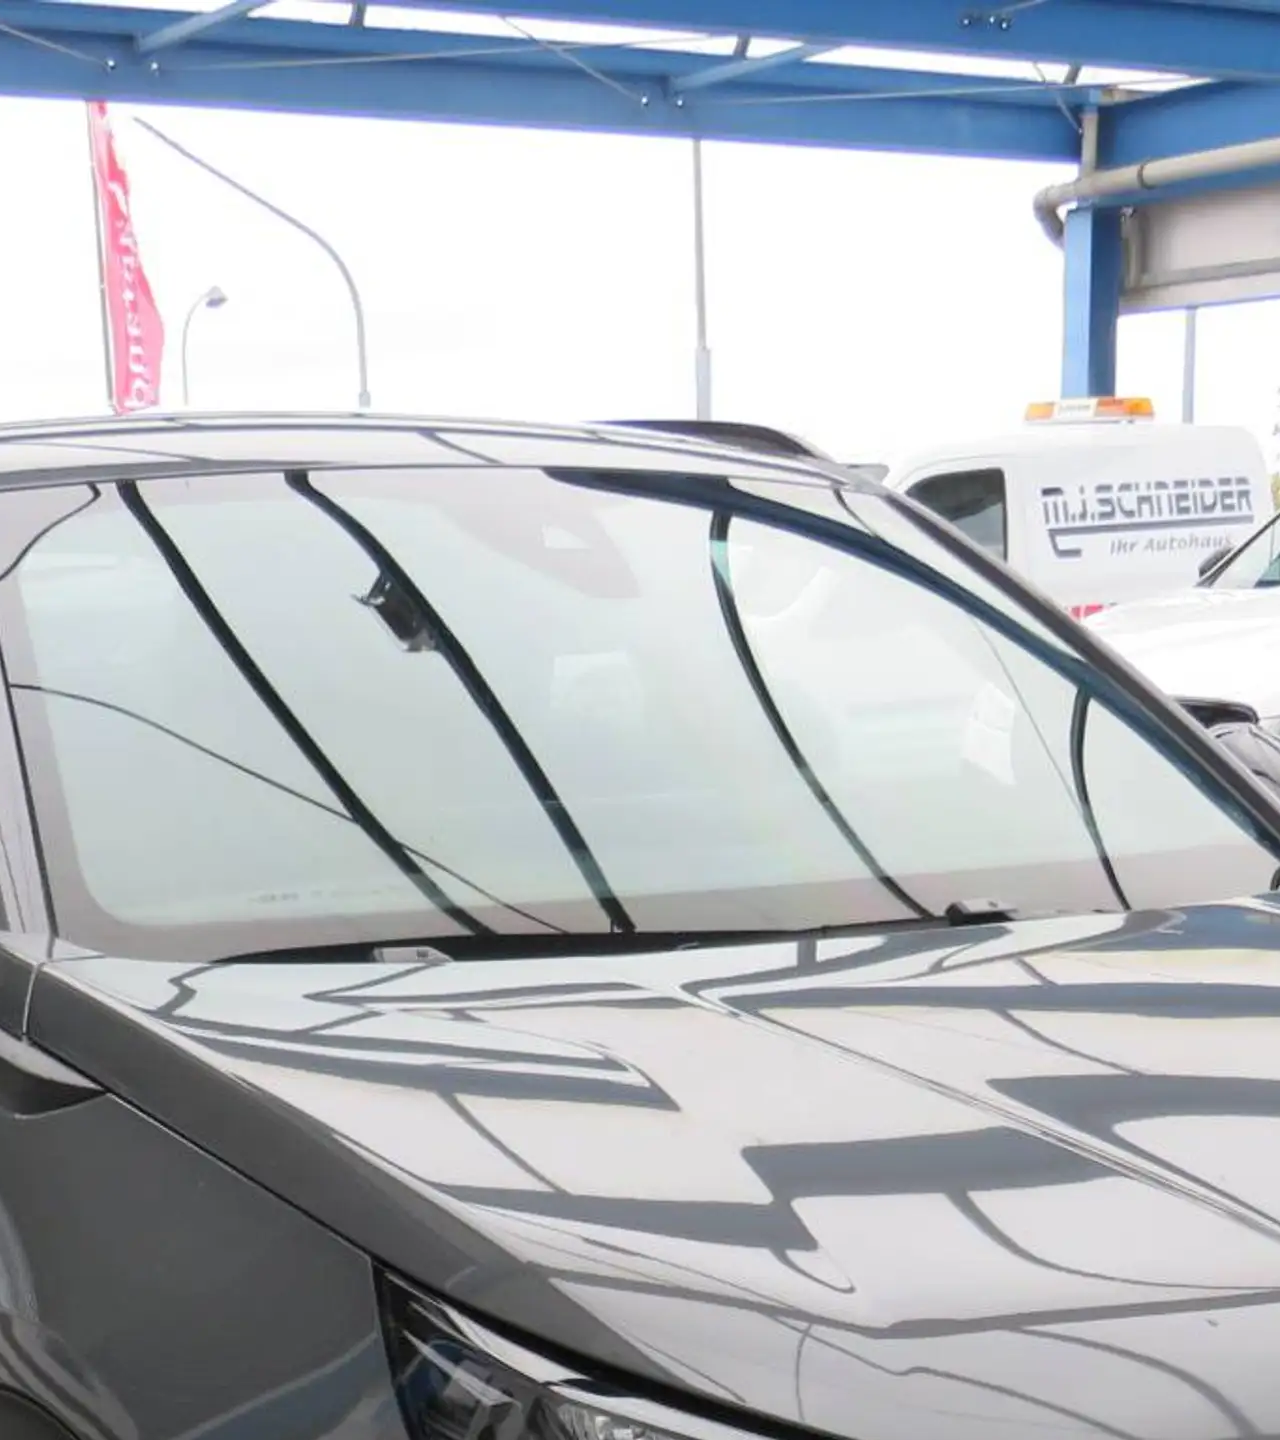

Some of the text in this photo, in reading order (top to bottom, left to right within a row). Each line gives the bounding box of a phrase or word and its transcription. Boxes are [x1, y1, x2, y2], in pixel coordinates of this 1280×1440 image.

[1041, 476, 1253, 525] M.J.SCHNEIDER
[1109, 532, 1233, 556] Ihr Autohaus
